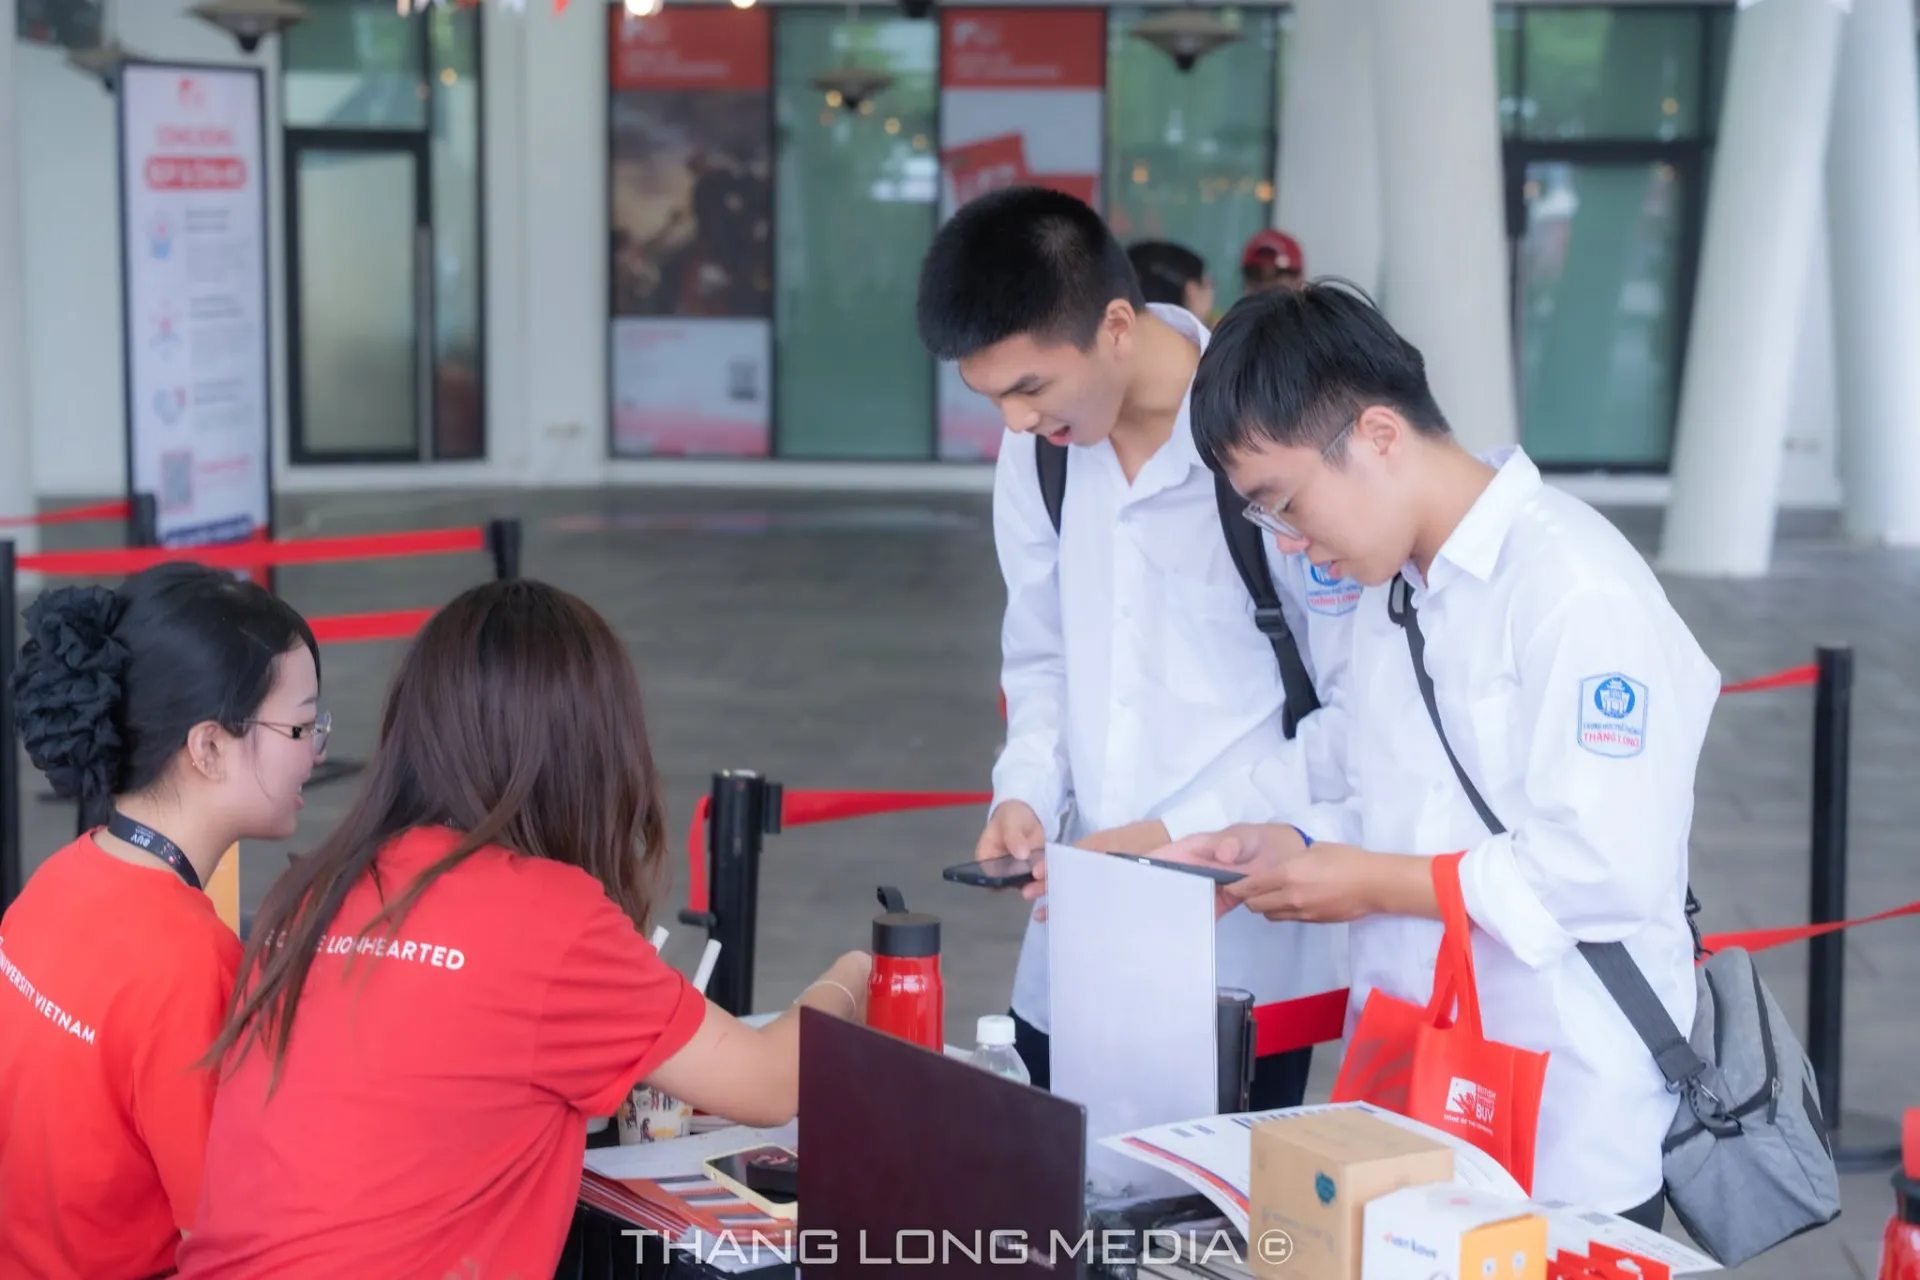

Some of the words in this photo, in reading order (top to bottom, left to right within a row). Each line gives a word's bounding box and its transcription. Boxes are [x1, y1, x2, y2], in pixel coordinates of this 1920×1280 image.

[327, 936, 465, 970] LIONHEARTED
[0, 948, 36, 1002] NIVERSITY
[35, 991, 96, 1045] VIETNAM
[1476, 1103, 1495, 1124] BUV
